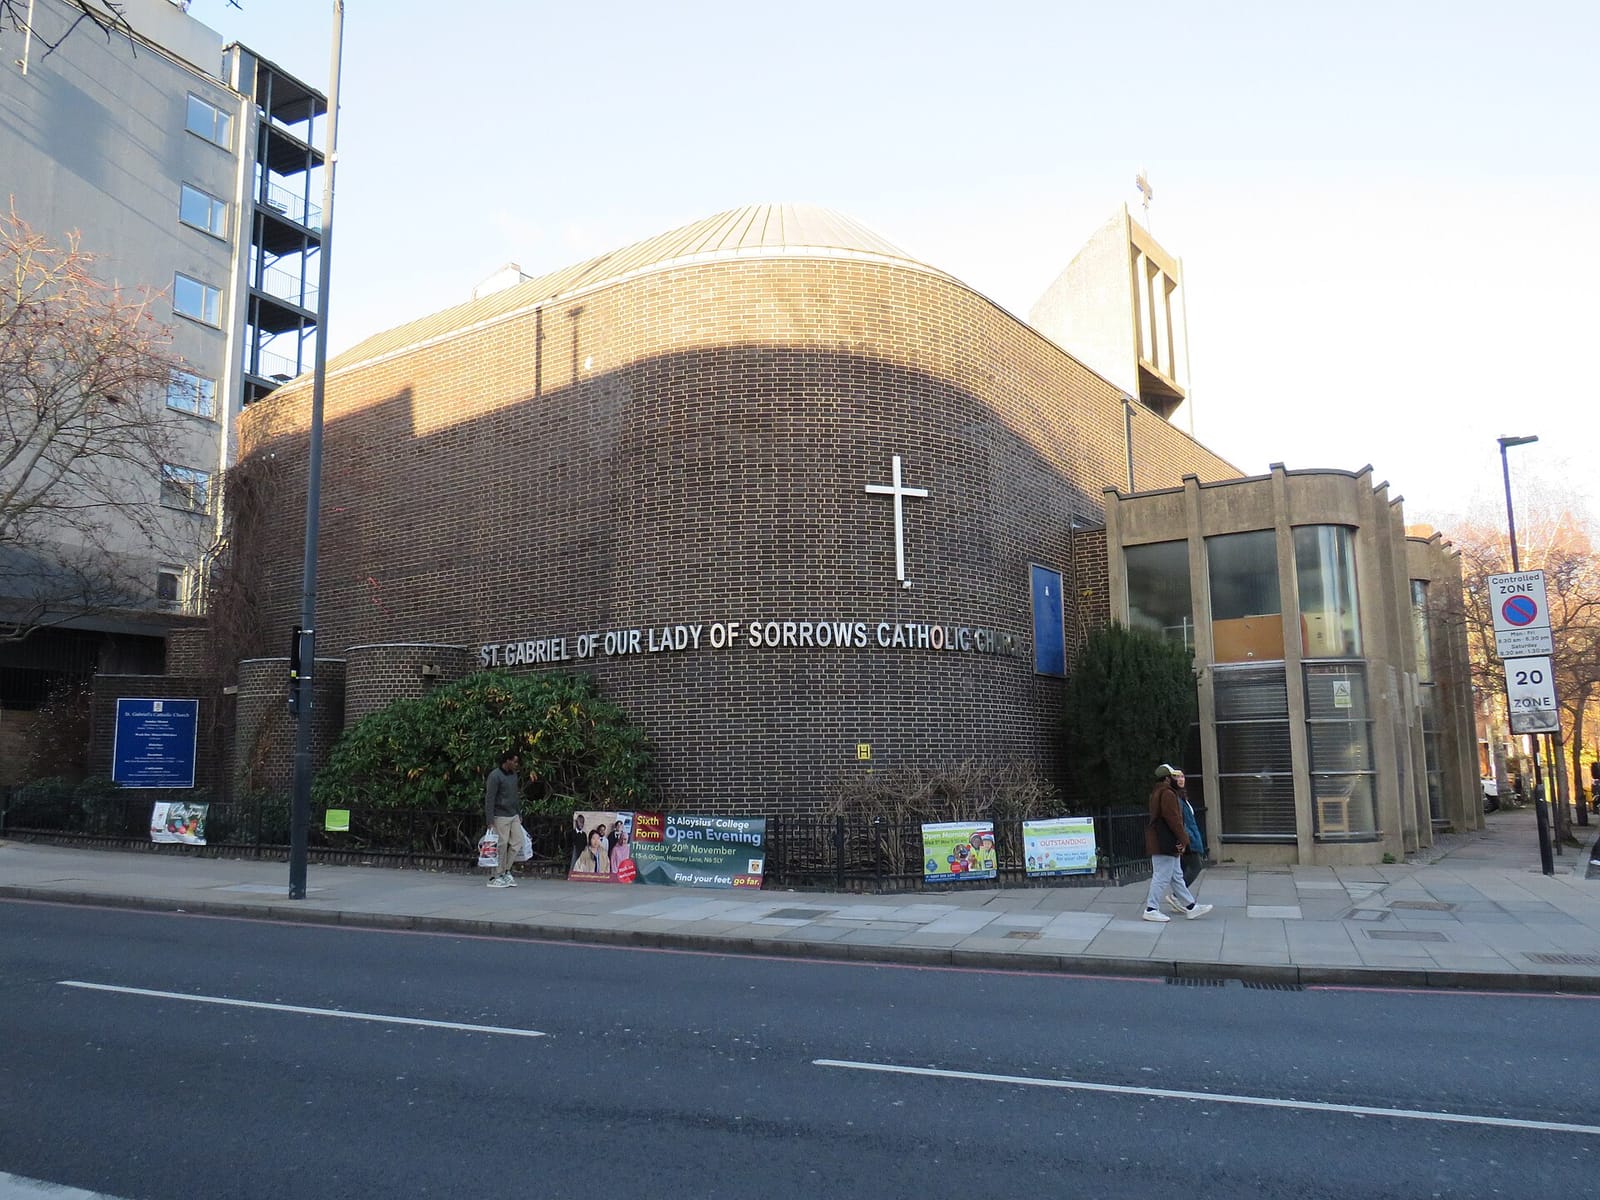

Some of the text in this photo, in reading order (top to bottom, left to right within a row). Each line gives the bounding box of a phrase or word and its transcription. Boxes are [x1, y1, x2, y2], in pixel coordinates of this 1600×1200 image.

[1492, 573, 1540, 584] Controlled
[1500, 583, 1534, 594] ZONE
[481, 645, 500, 668] ST.
[505, 638, 571, 666] GABRIEL
[577, 633, 600, 658] OF
[605, 629, 642, 655] OUR
[649, 624, 703, 652] LADY
[710, 622, 740, 648] OF
[749, 621, 868, 648] SORROWS
[877, 622, 970, 651] CATHOLIC
[1515, 670, 1543, 685] 20
[1514, 697, 1551, 707] ZONE
[636, 815, 660, 826] Sixth
[667, 816, 750, 831] St Aloysius' College
[635, 828, 660, 839] Form
[665, 825, 762, 847] Open Evening
[923, 833, 941, 841] Open
[1040, 838, 1087, 847] OUTSTANDING
[632, 842, 737, 856] Thursday 20th November
[674, 872, 760, 886] Find your feet, go far.
